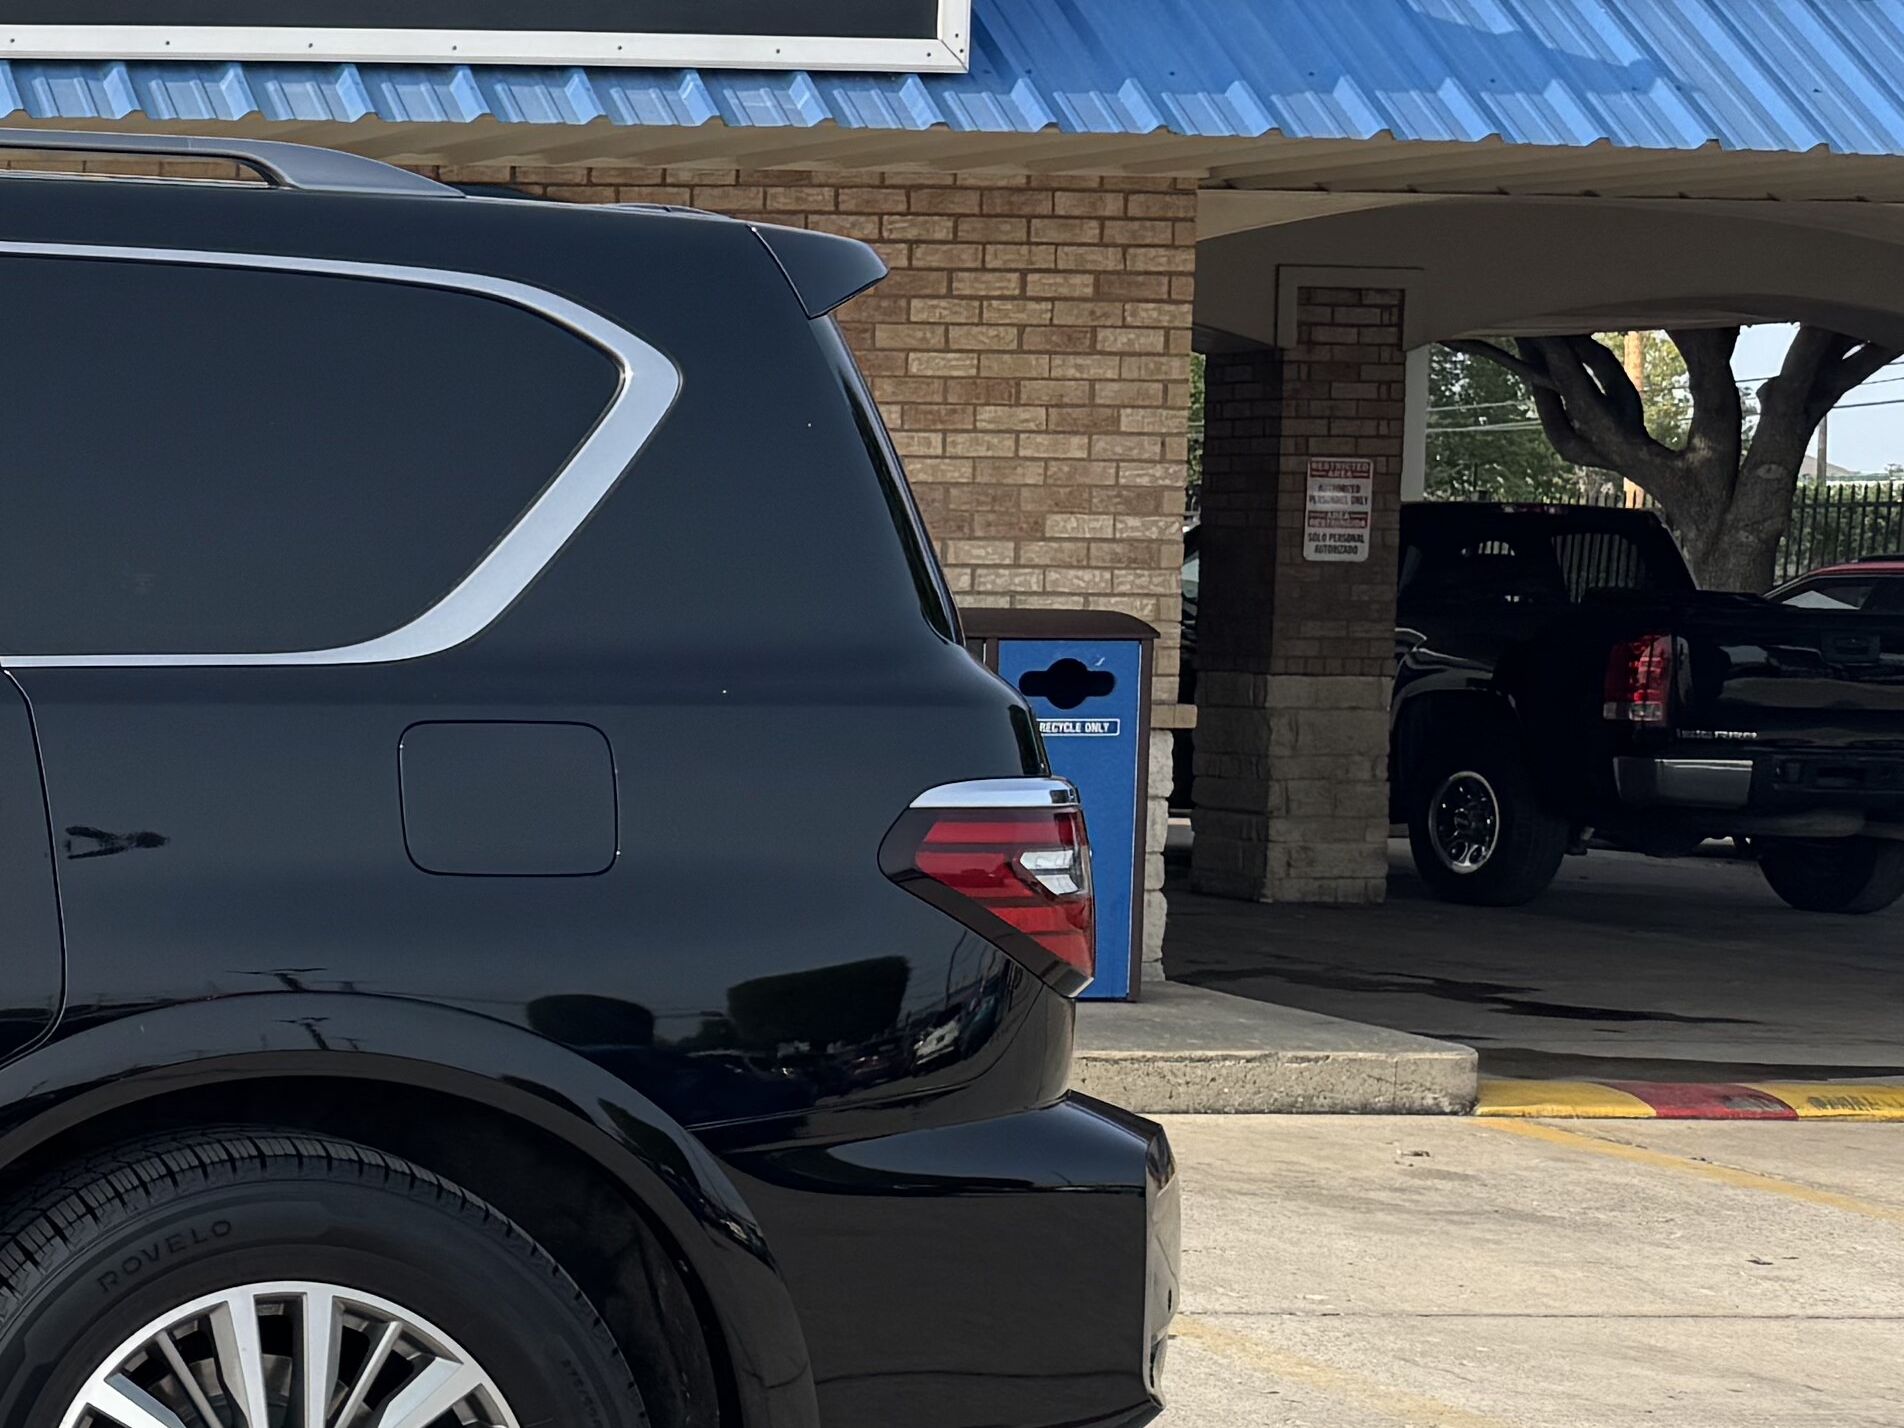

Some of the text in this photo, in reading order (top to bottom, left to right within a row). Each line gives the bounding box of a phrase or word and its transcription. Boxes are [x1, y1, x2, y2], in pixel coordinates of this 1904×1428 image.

[1311, 461, 1369, 471] RESTRICTED
[1329, 533, 1365, 543] PERSONAL
[1314, 544, 1358, 555] AUTORIZADO
[1039, 722, 1110, 733] RECYCLE ONLY
[96, 1219, 233, 1293] ROVELO
